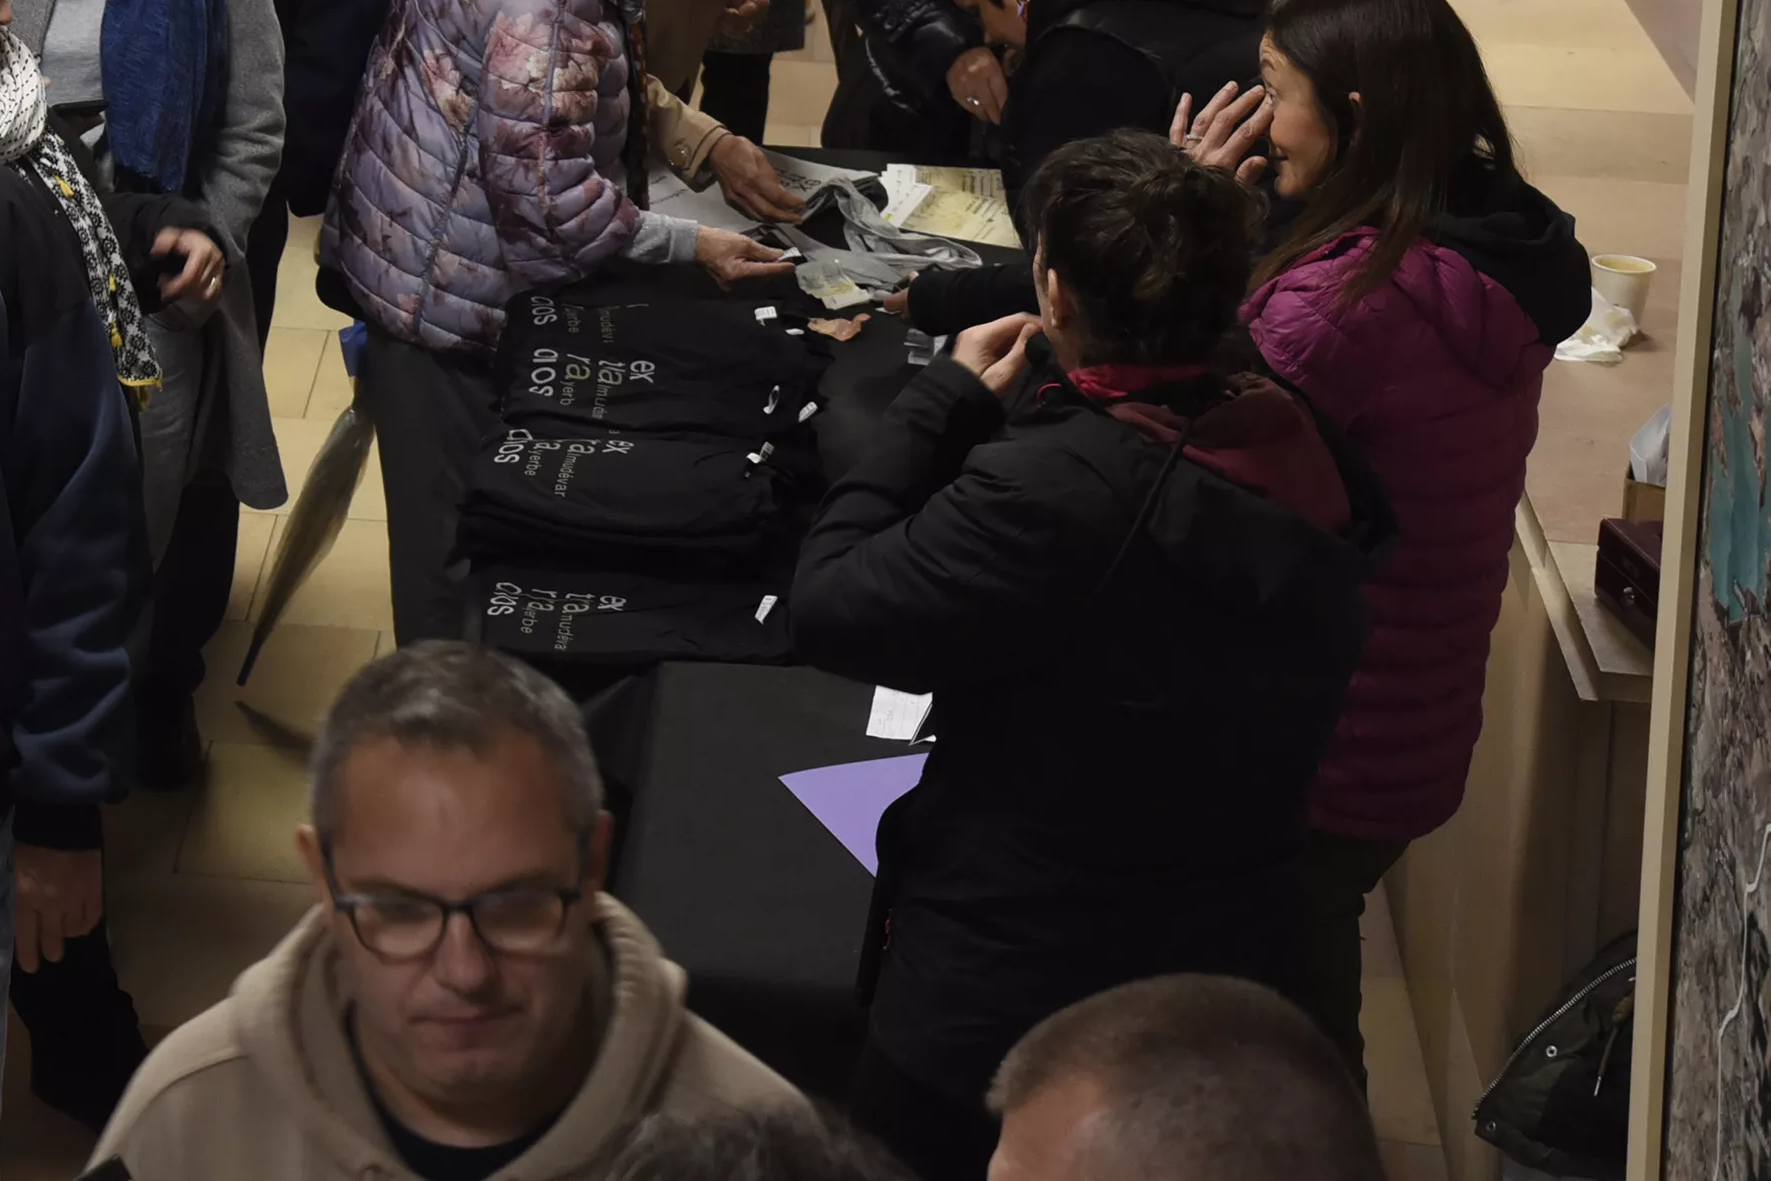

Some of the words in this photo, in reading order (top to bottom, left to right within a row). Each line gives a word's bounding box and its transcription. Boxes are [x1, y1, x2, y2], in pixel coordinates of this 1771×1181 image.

[629, 360, 655, 384] ex
[602, 440, 635, 454] ex
[597, 595, 627, 612] ex
